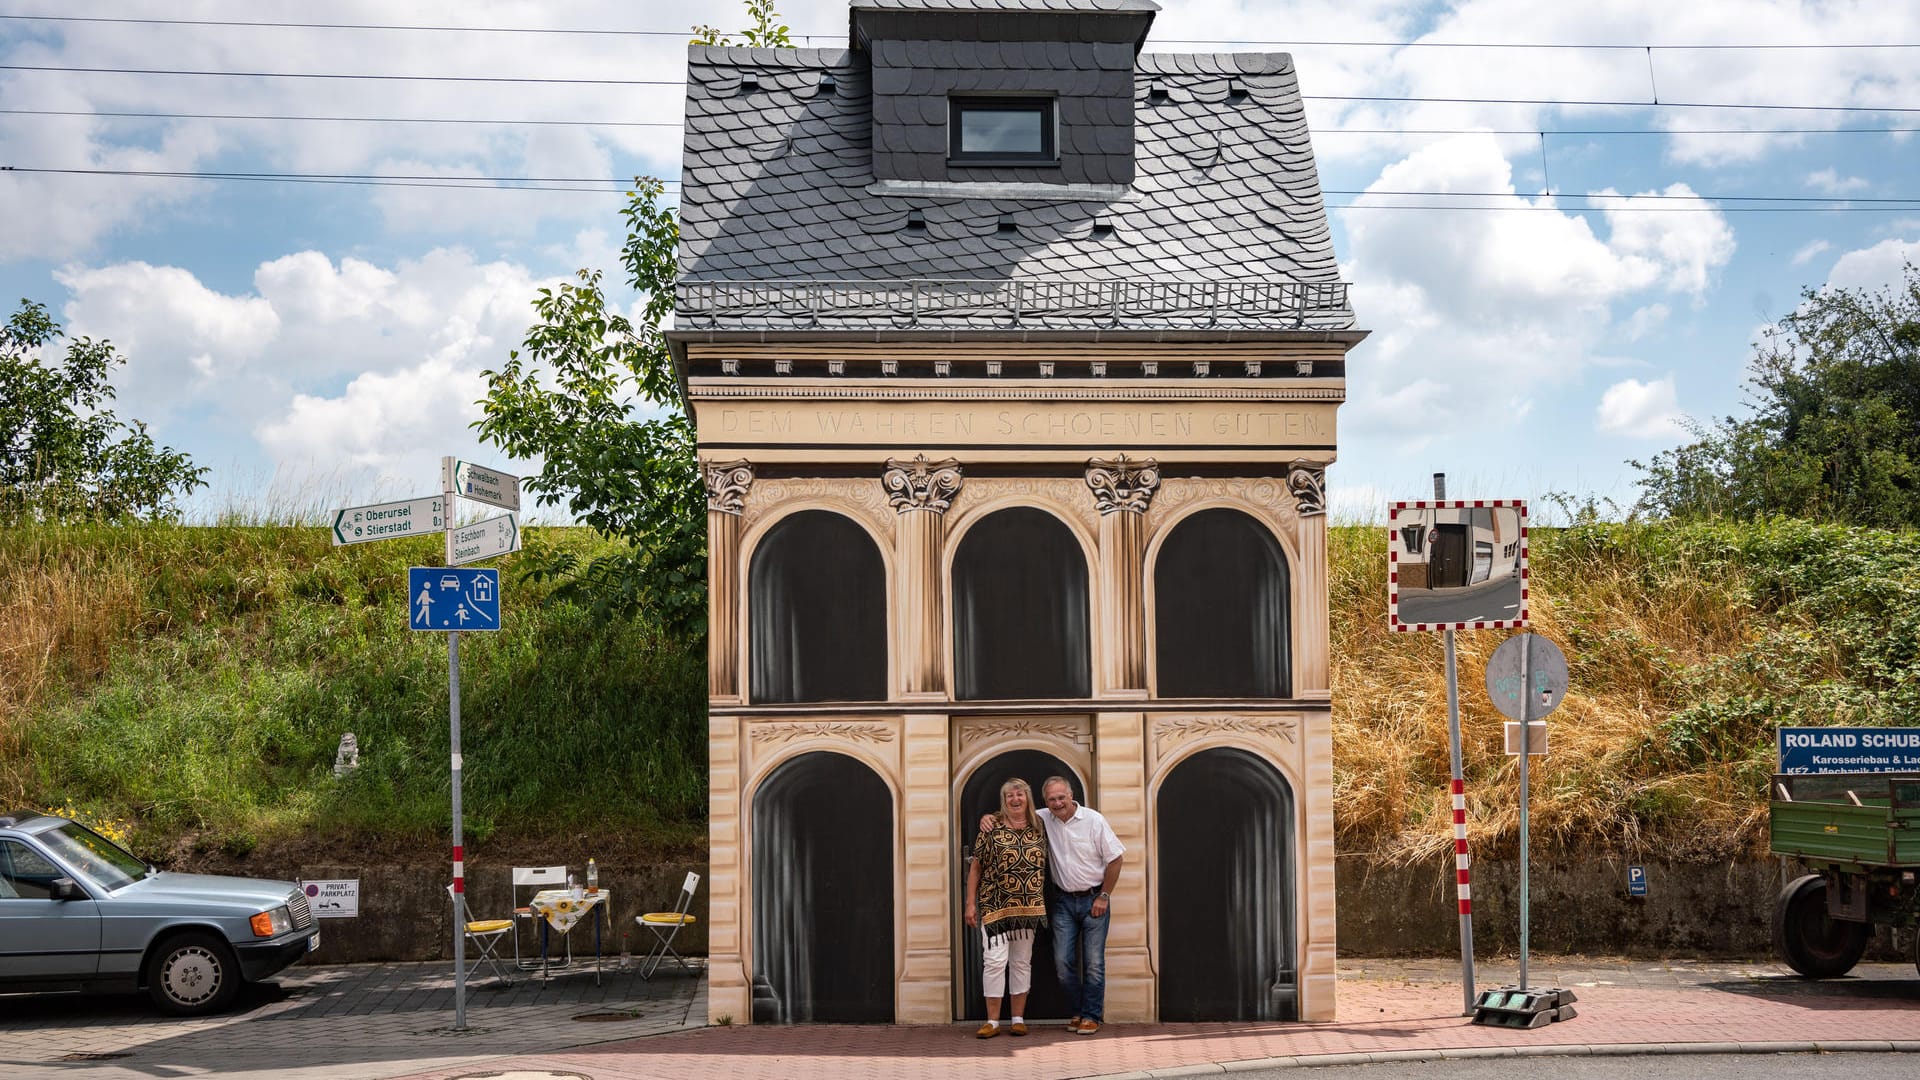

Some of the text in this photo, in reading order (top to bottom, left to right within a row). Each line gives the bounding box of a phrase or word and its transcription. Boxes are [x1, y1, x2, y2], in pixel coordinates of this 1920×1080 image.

[722, 410, 791, 433] DEM
[816, 410, 975, 435] WAHREN
[998, 411, 1193, 436] SCHOENEN
[474, 484, 502, 500] Hohemark
[366, 505, 411, 521] Oberursel
[367, 520, 411, 535] Stierstadt
[461, 529, 485, 543] Eschborn
[455, 544, 480, 560] Steinbach
[1785, 734, 1920, 748] ROLAND SCHUB
[1812, 755, 1889, 764] Karosseriebau
[1892, 755, 1901, 764] &
[1631, 868, 1642, 881] P
